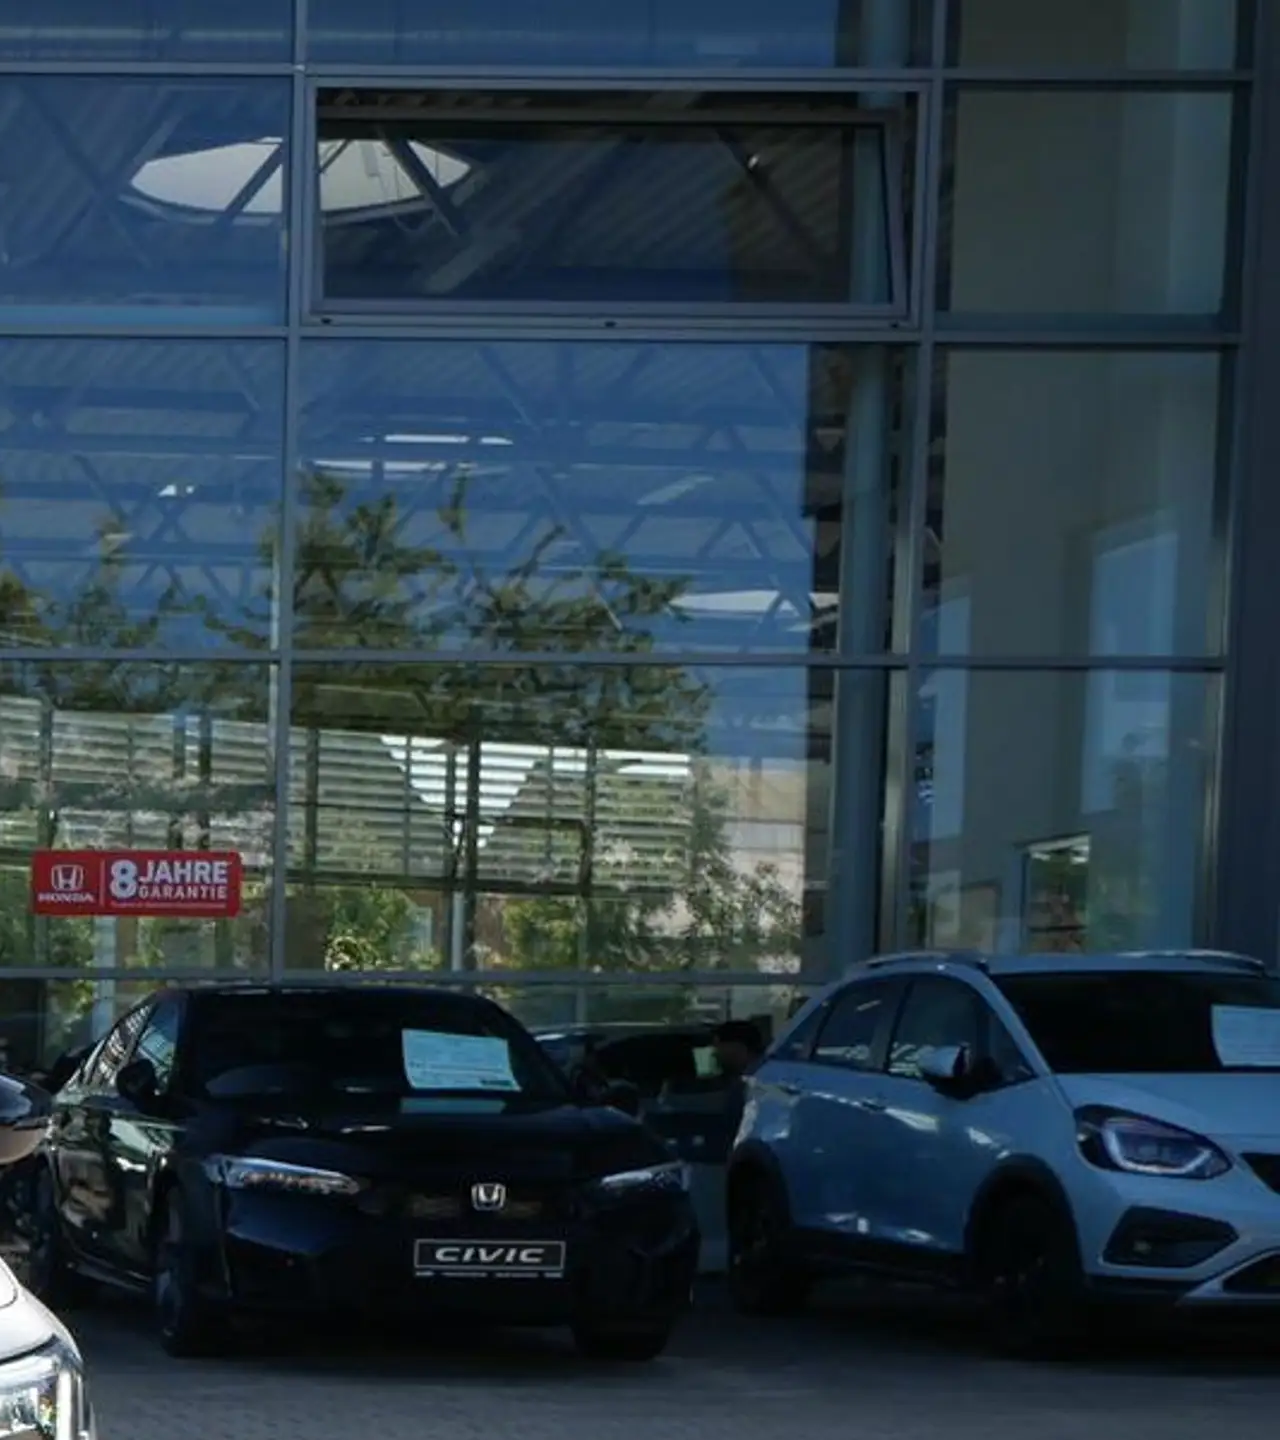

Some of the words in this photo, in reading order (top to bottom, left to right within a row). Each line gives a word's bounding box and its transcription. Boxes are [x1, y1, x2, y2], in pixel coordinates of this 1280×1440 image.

[109, 859, 139, 899] 8
[139, 860, 228, 885] JAHRE
[37, 892, 94, 903] HONDA
[139, 885, 228, 899] GARANTIE
[435, 1246, 546, 1264] CIVIC
